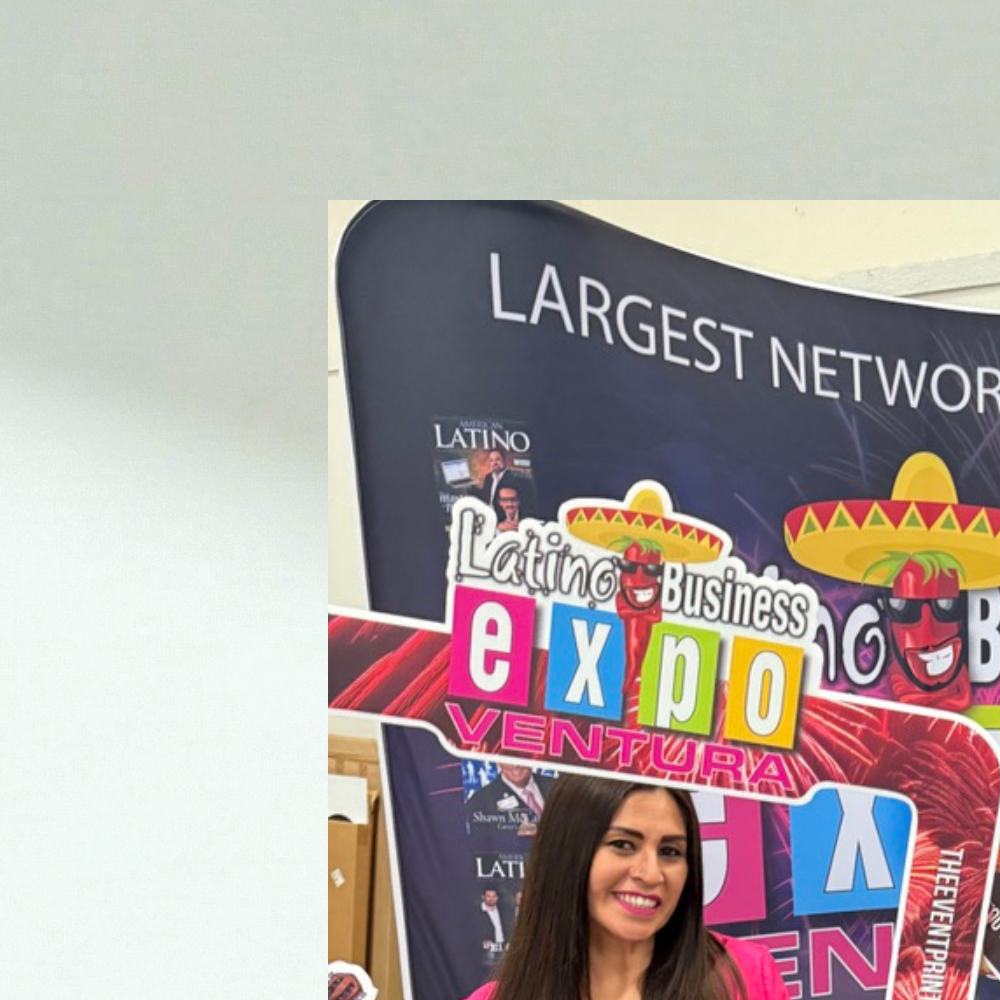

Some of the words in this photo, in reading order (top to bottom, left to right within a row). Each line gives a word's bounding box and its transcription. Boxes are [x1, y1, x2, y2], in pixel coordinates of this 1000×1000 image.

[490, 252, 754, 381] LARGEST
[434, 423, 530, 452] LATINO
[457, 508, 619, 605] Latino
[661, 562, 810, 638] Business
[469, 601, 787, 738] expo
[446, 702, 794, 791] VENTURA
[475, 857, 525, 879] LATI
